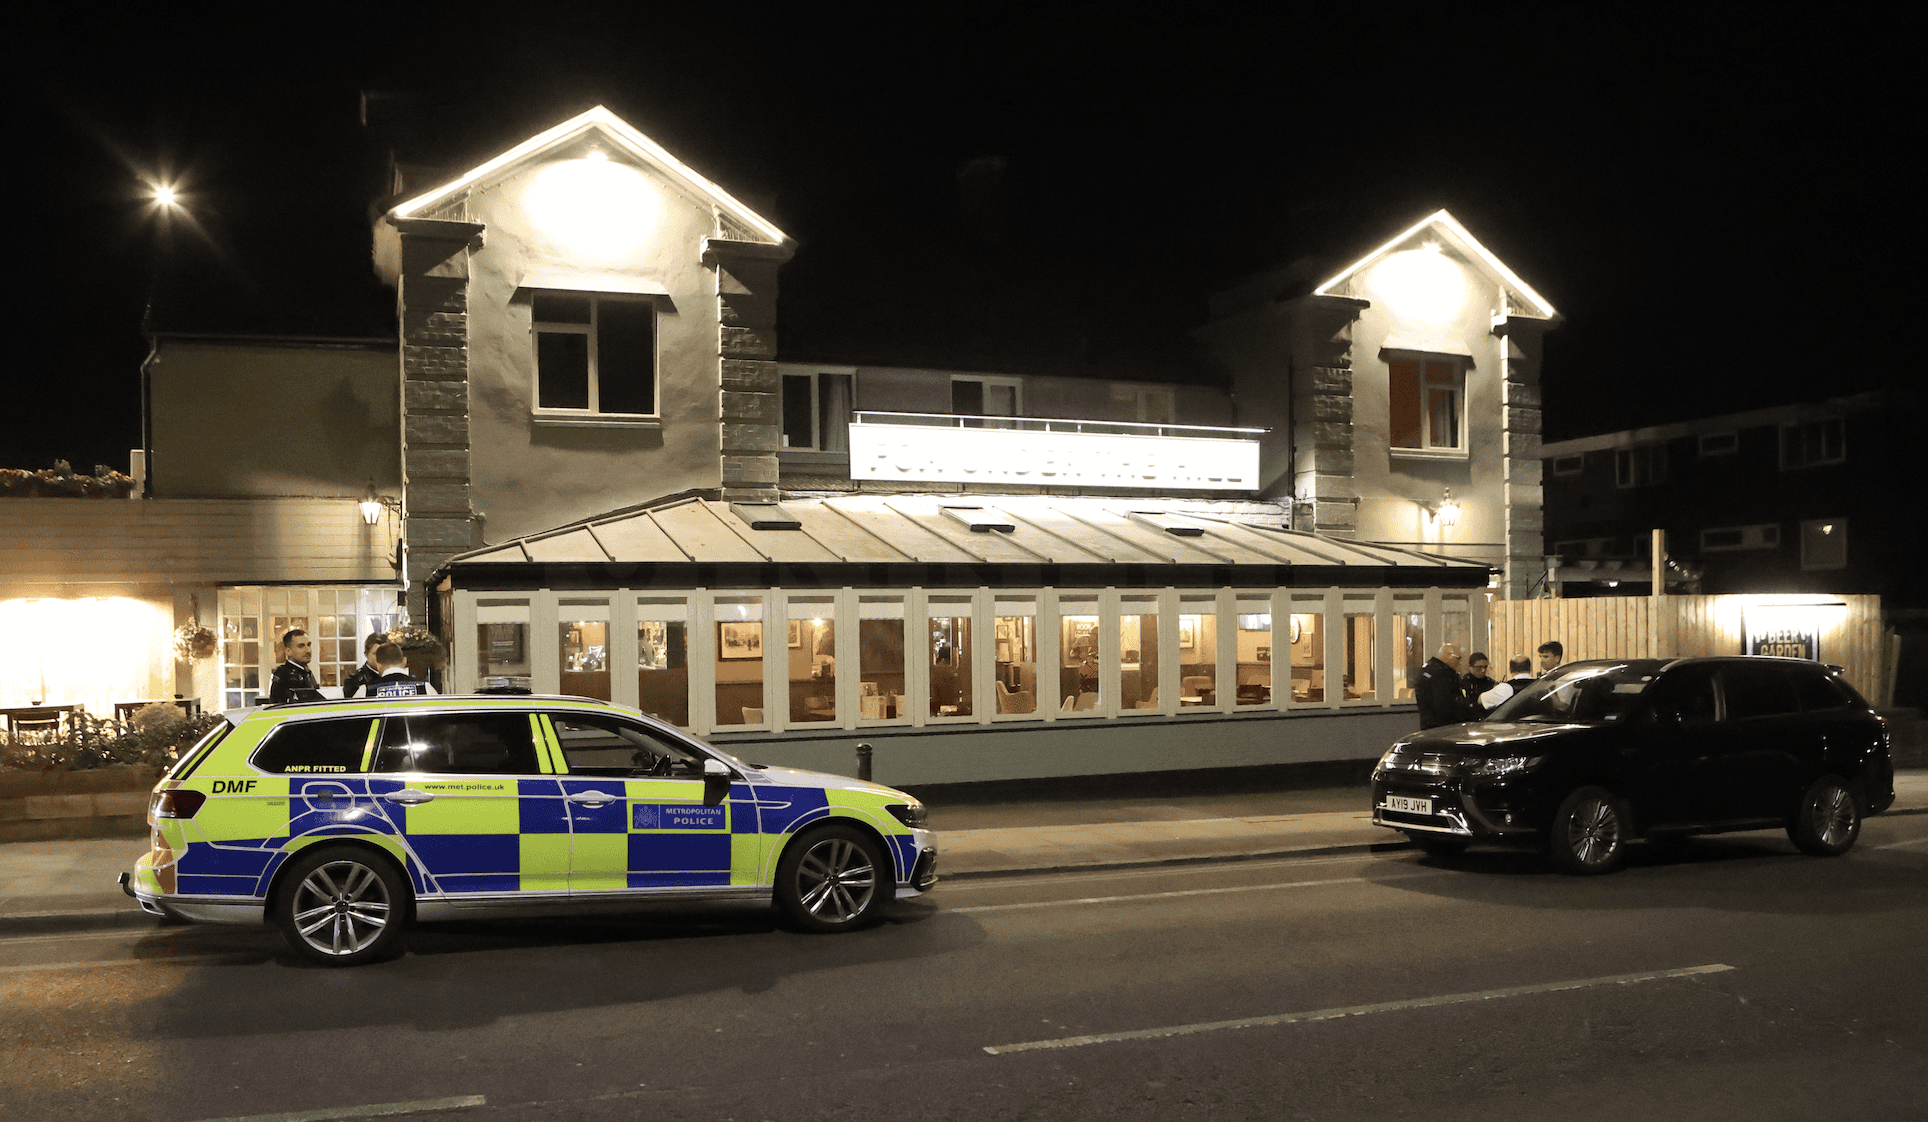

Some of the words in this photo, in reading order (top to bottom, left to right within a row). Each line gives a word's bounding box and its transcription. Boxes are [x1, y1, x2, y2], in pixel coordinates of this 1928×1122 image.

[1768, 629, 1798, 643] BEER
[1760, 644, 1806, 658] GARDEN
[378, 689, 415, 698] POLICE
[212, 781, 257, 794] DMF
[1391, 798, 1409, 810] AY19
[1410, 800, 1427, 812] JVH
[673, 817, 714, 825] POLICE
